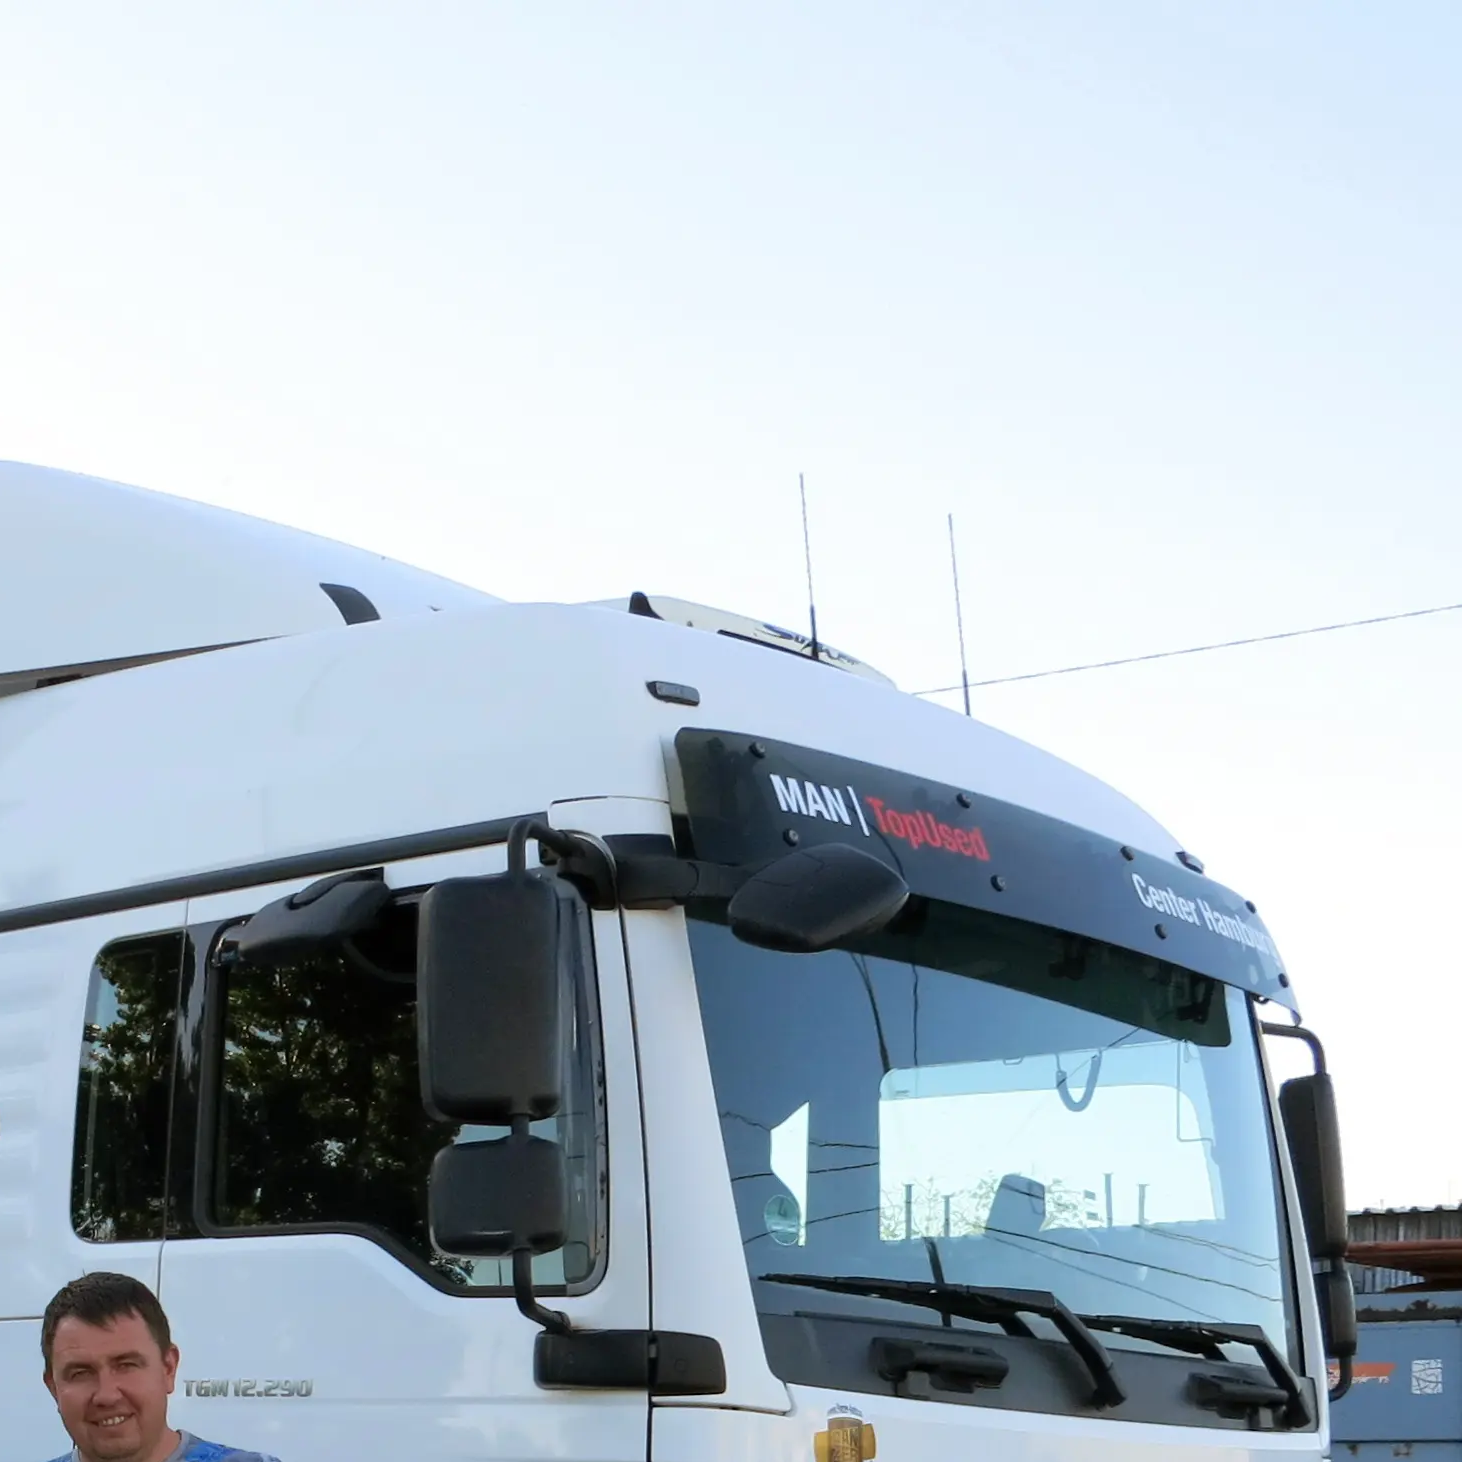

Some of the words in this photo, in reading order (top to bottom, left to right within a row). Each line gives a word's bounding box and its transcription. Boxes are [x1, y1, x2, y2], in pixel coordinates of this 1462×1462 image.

[769, 773, 852, 826] MAN
[864, 796, 991, 862] TopUsed
[1131, 872, 1202, 927] Center
[1195, 897, 1281, 968] Hambur
[183, 1378, 229, 1397] TGM
[232, 1378, 314, 1398] 12.290
